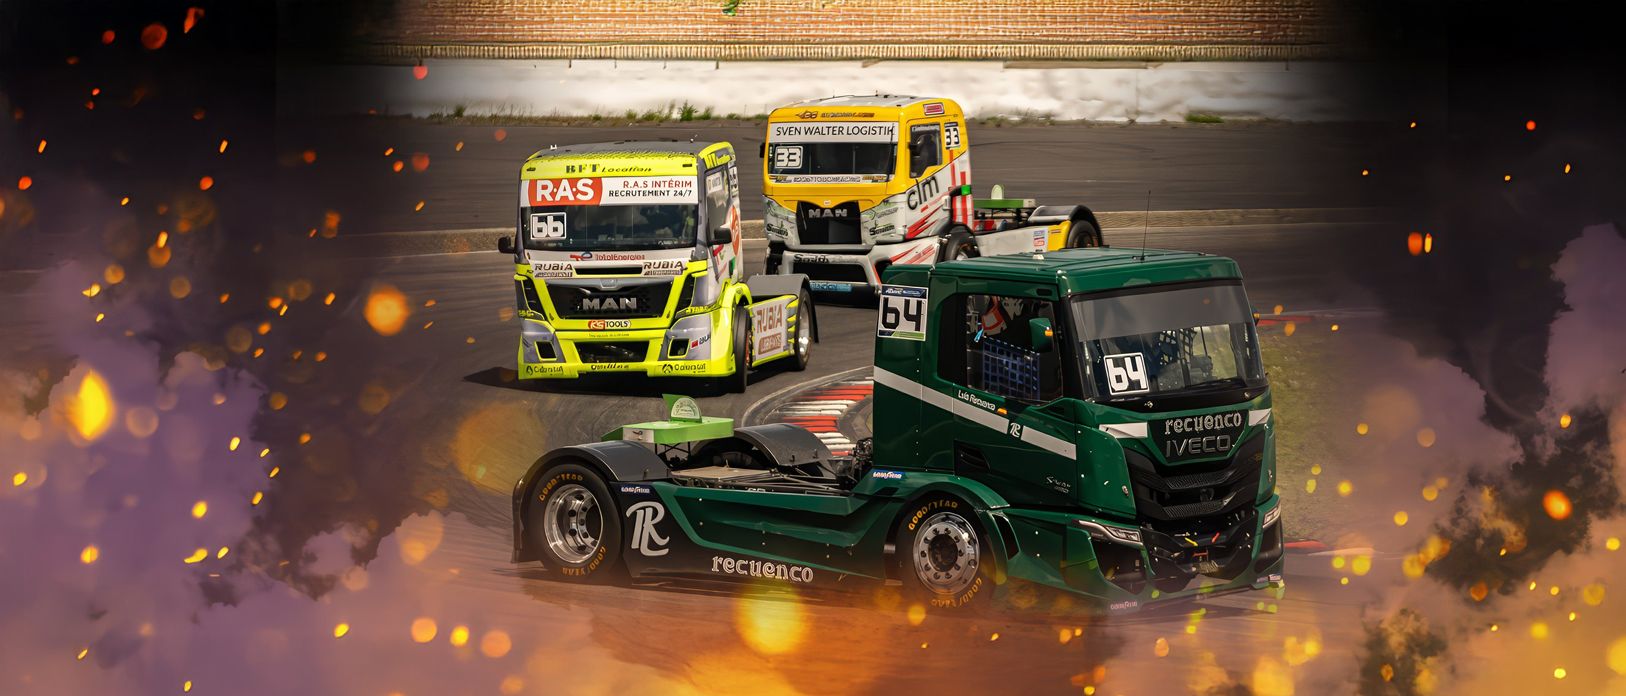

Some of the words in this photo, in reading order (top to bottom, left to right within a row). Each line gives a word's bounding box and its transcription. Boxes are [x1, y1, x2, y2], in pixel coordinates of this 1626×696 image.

[776, 126, 801, 136] SVEN
[804, 125, 844, 136] WALTER
[846, 124, 894, 136] LOGISTIK
[945, 127, 959, 146] 33
[776, 147, 801, 168] 33
[651, 179, 692, 188] INTÉRIM
[608, 189, 670, 198] RECRUTEMENT
[673, 189, 692, 197] 24/7
[808, 208, 848, 218] MAN
[582, 297, 638, 311] MAN
[881, 296, 923, 332] 64
[606, 320, 630, 328] TOOLS
[1106, 355, 1147, 392] 64
[1164, 411, 1242, 435] recuenco
[1165, 435, 1230, 458] IVECO
[711, 555, 814, 583] recuenco
